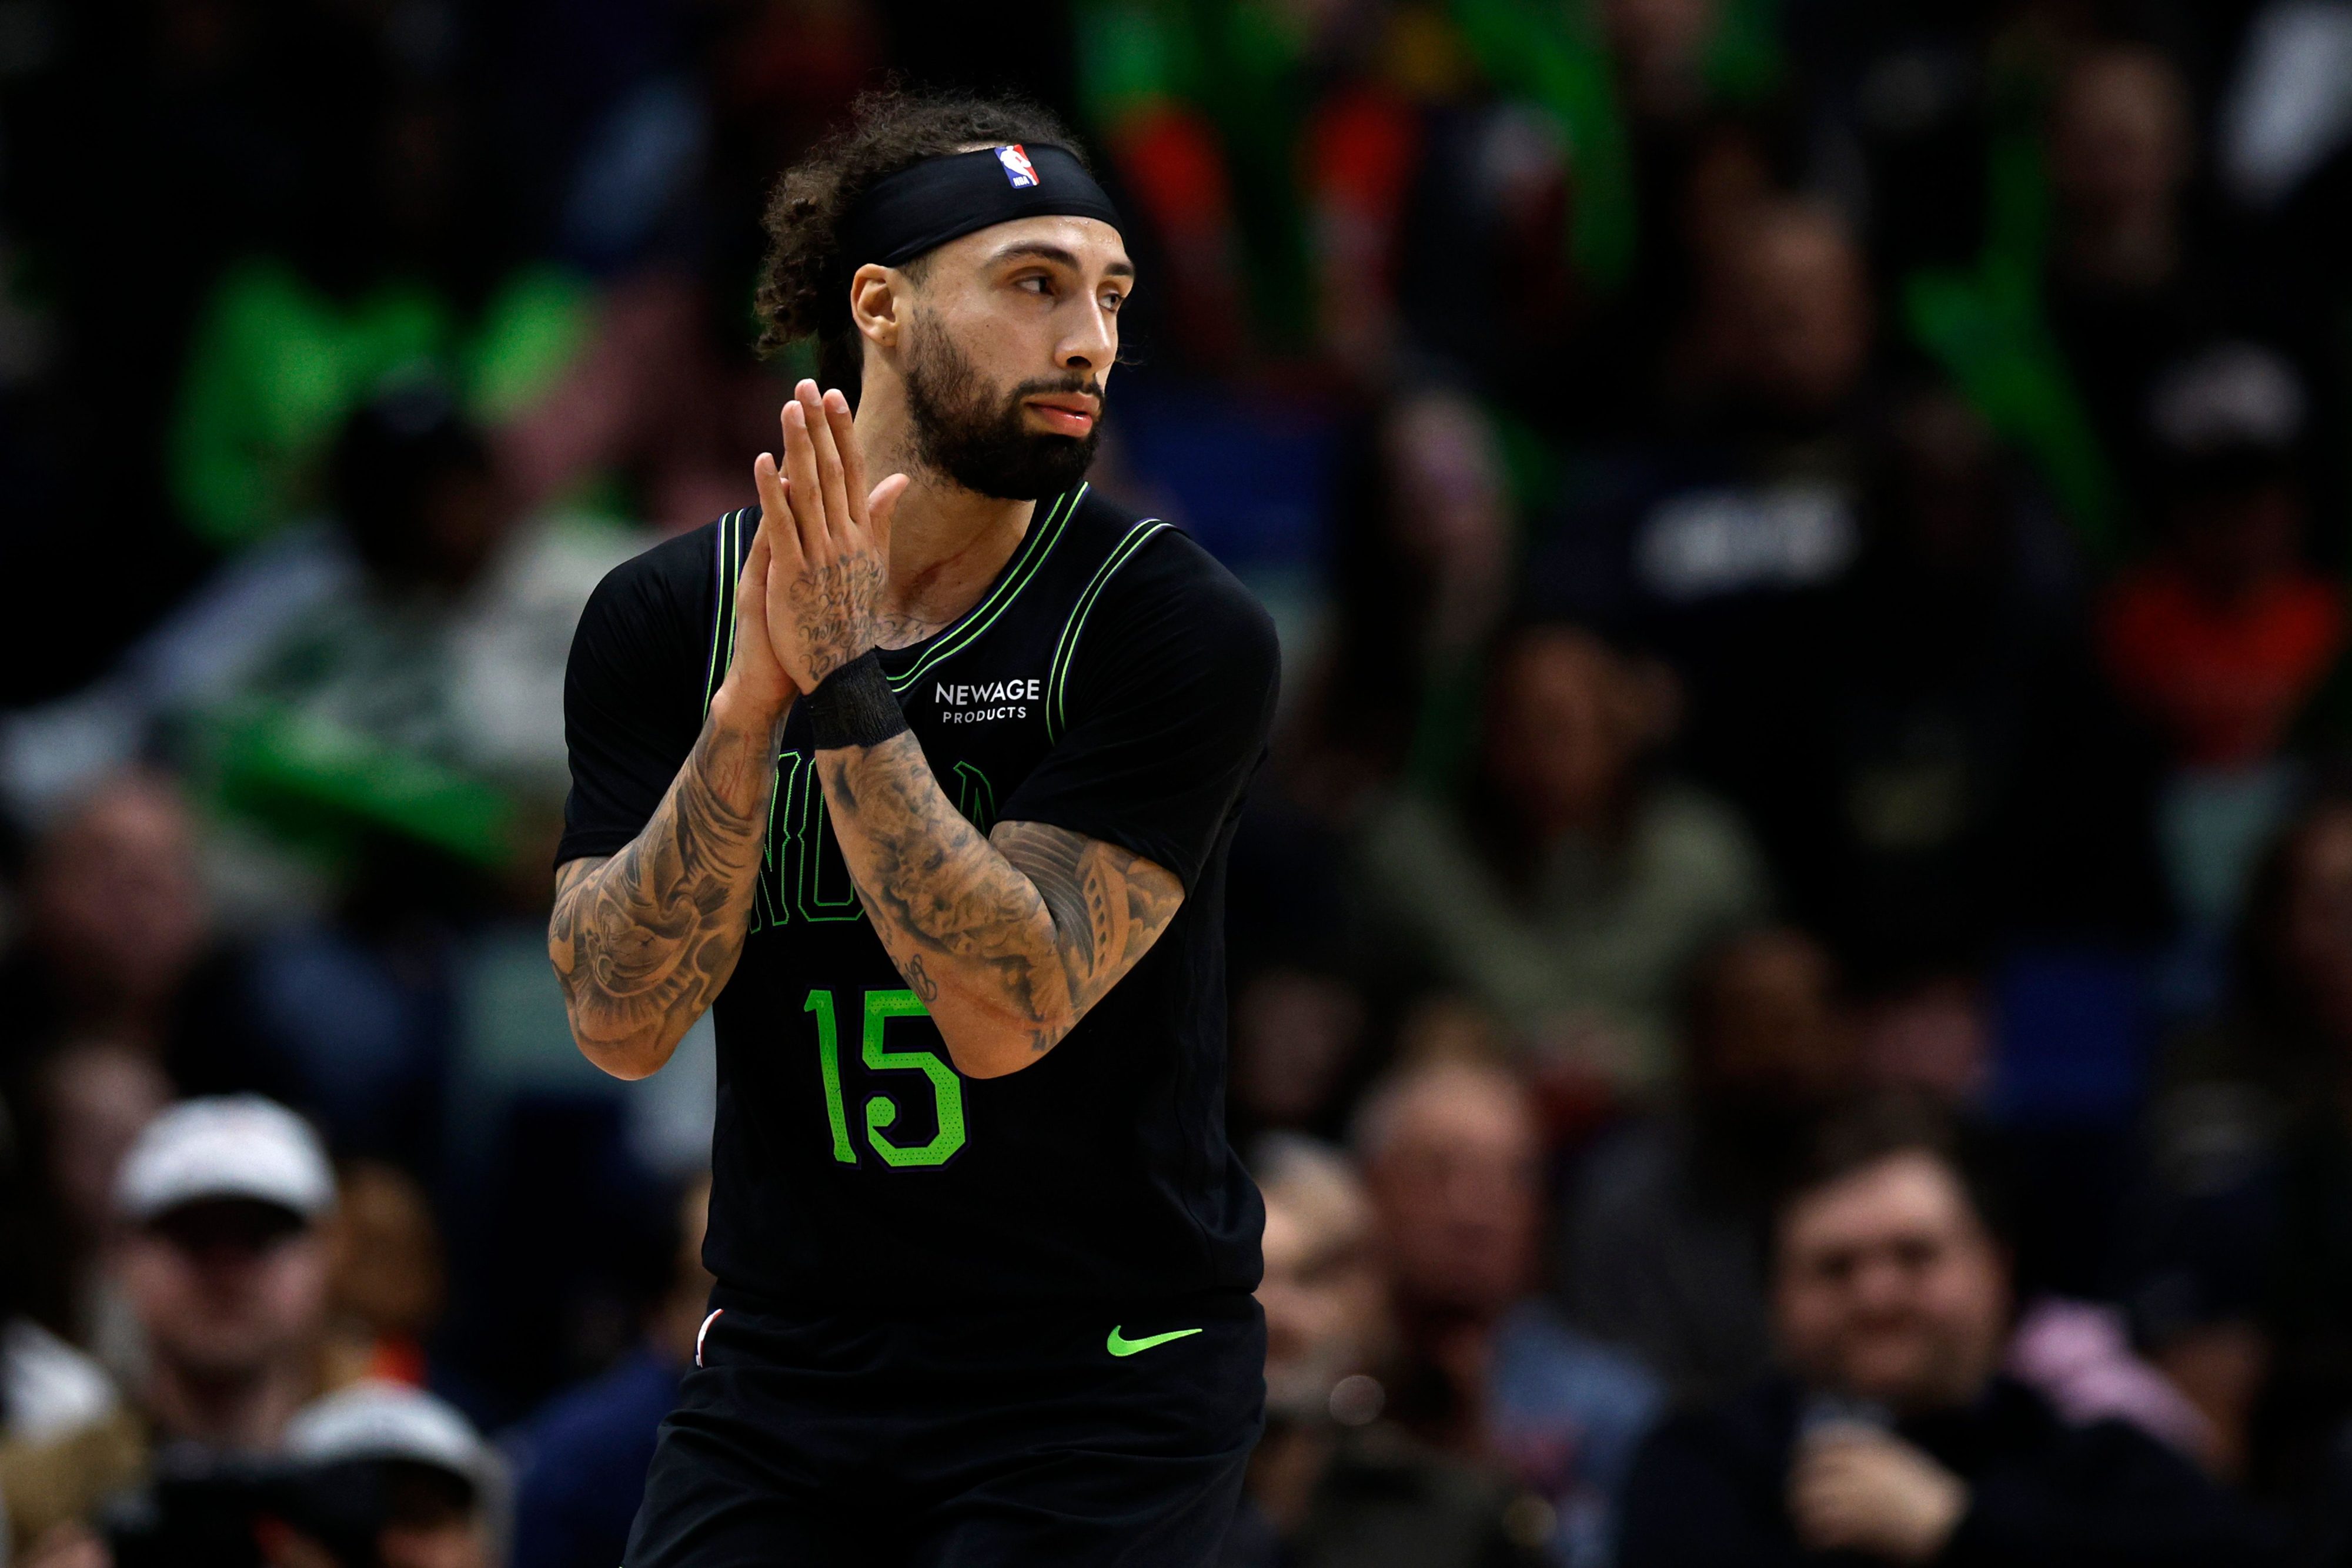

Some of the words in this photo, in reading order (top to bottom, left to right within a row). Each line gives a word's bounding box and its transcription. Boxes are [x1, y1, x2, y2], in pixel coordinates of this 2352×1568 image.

[1013, 176, 1030, 187] NBA
[935, 678, 1040, 706] NEWAGE
[943, 706, 1027, 724] PRODUCTS
[802, 988, 967, 1168] 15
